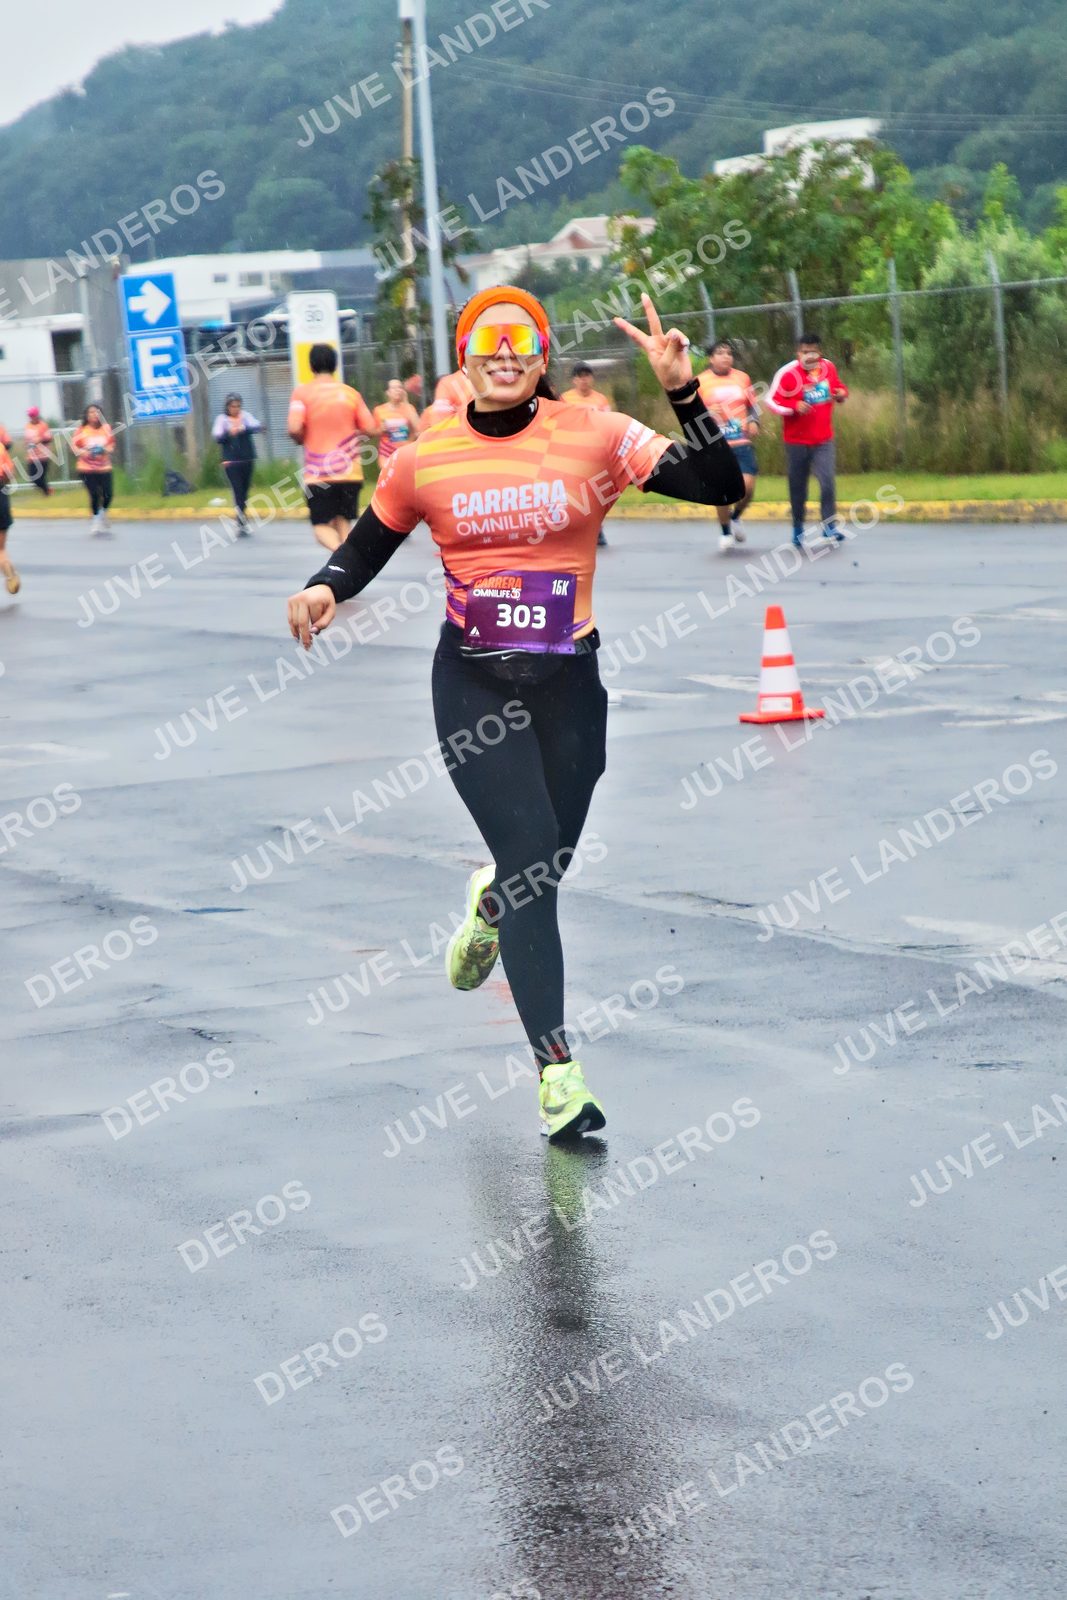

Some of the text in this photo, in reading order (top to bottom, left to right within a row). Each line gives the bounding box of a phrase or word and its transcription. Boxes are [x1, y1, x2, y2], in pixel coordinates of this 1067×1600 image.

[136, 335, 179, 390] E
[452, 481, 567, 518] CARRERA
[456, 511, 544, 536] OMNILIFE
[473, 576, 523, 589] CARRERA
[473, 588, 511, 598] OMNILIFE
[496, 603, 547, 629] 303
